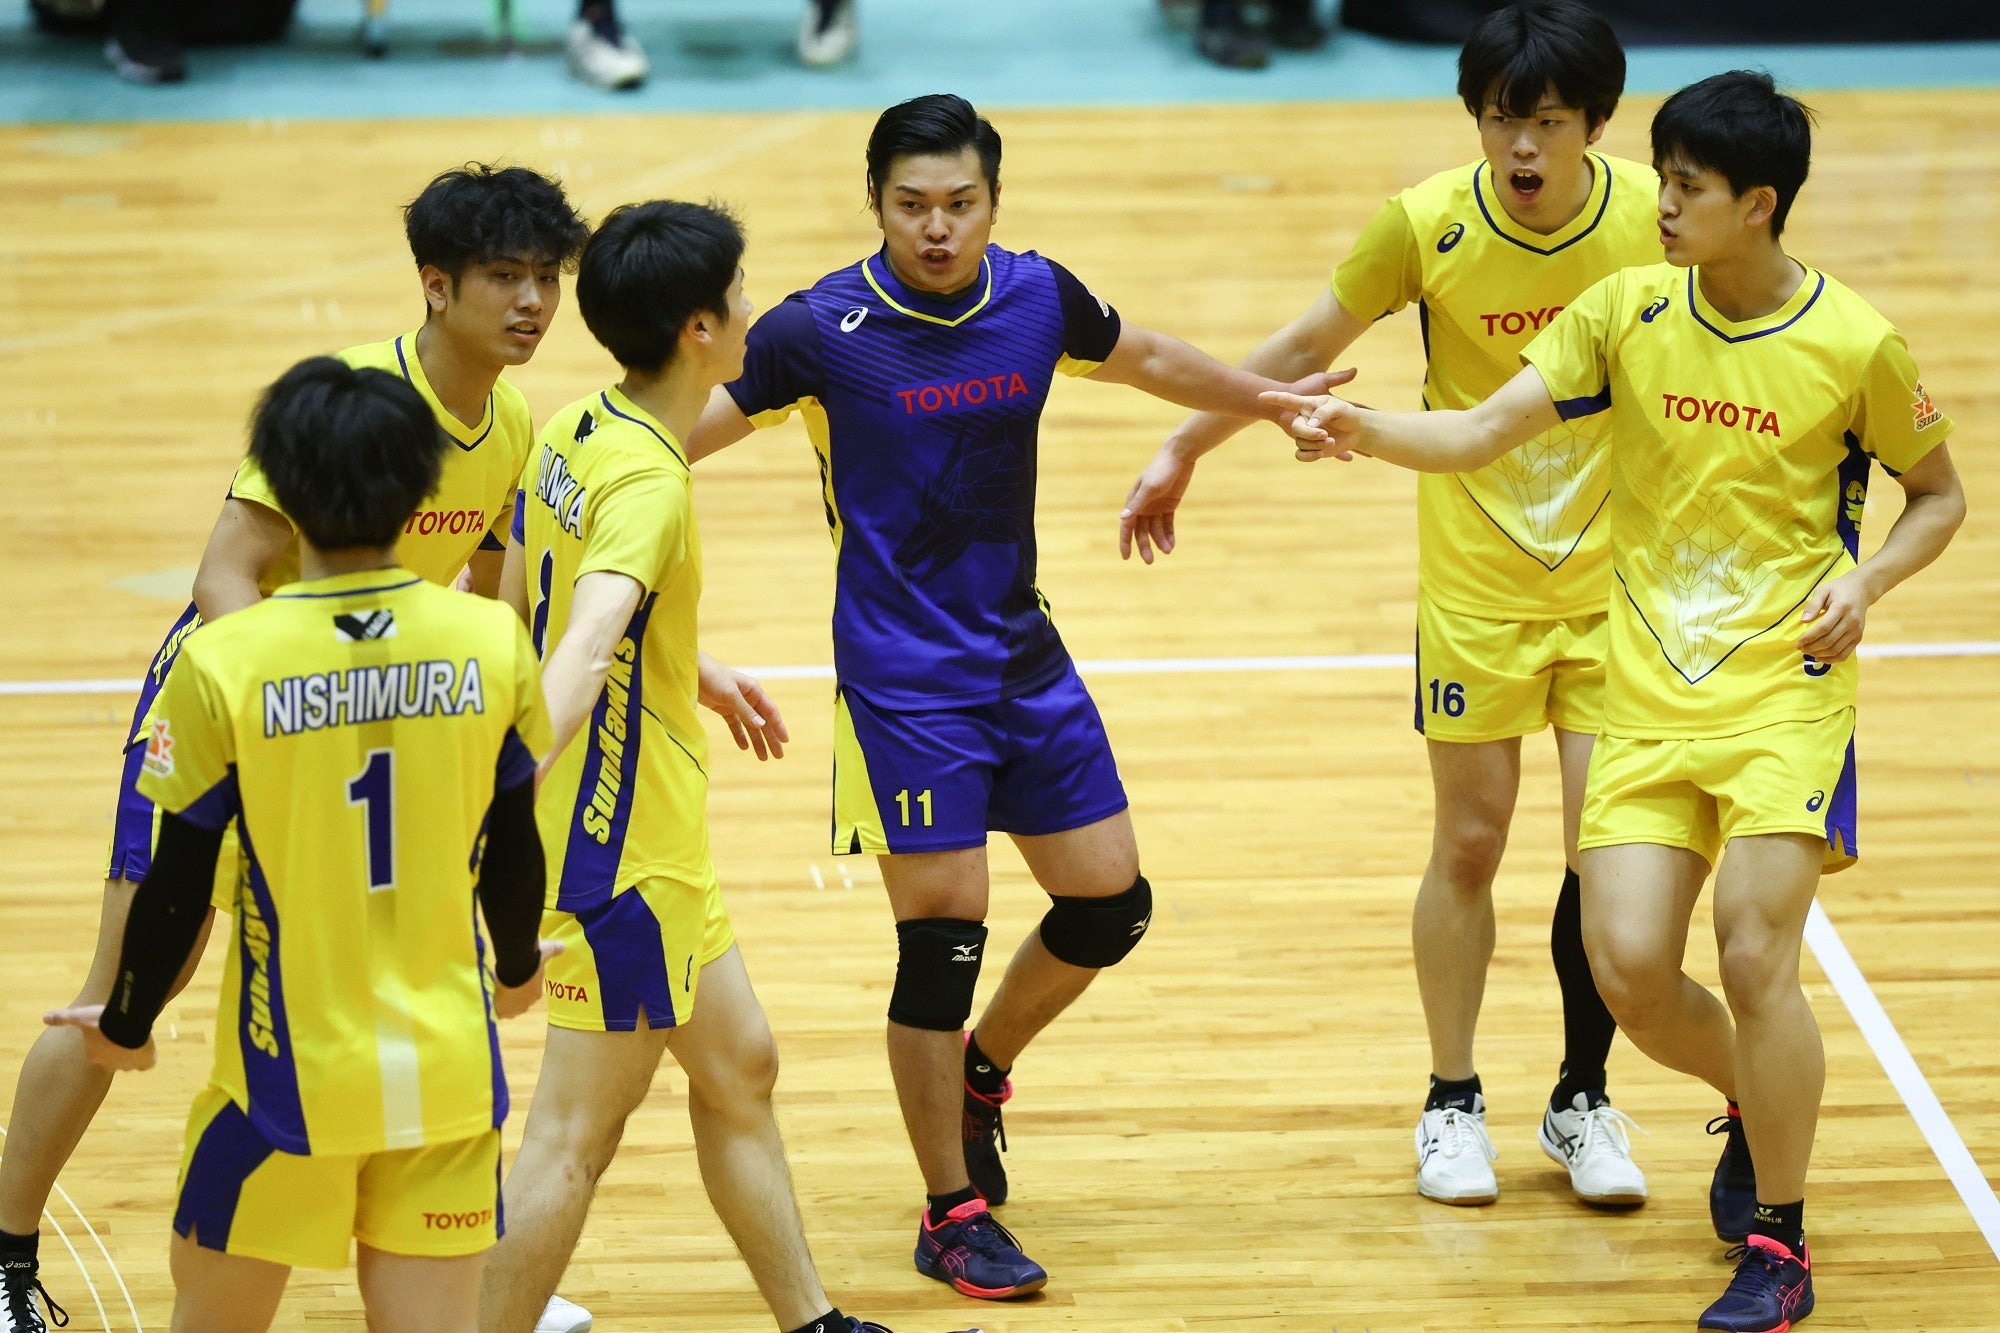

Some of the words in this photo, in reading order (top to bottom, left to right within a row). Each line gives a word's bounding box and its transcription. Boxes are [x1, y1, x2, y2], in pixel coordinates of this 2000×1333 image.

[897, 372, 1028, 414] TOYOTA
[1662, 394, 1780, 437] TOYOTA
[405, 510, 484, 535] TOYOTA
[263, 658, 484, 738] NISHIMURA
[1429, 678, 1466, 718] 16
[345, 747, 396, 893] 1
[895, 788, 933, 827] 11
[545, 978, 588, 1003] YOTA
